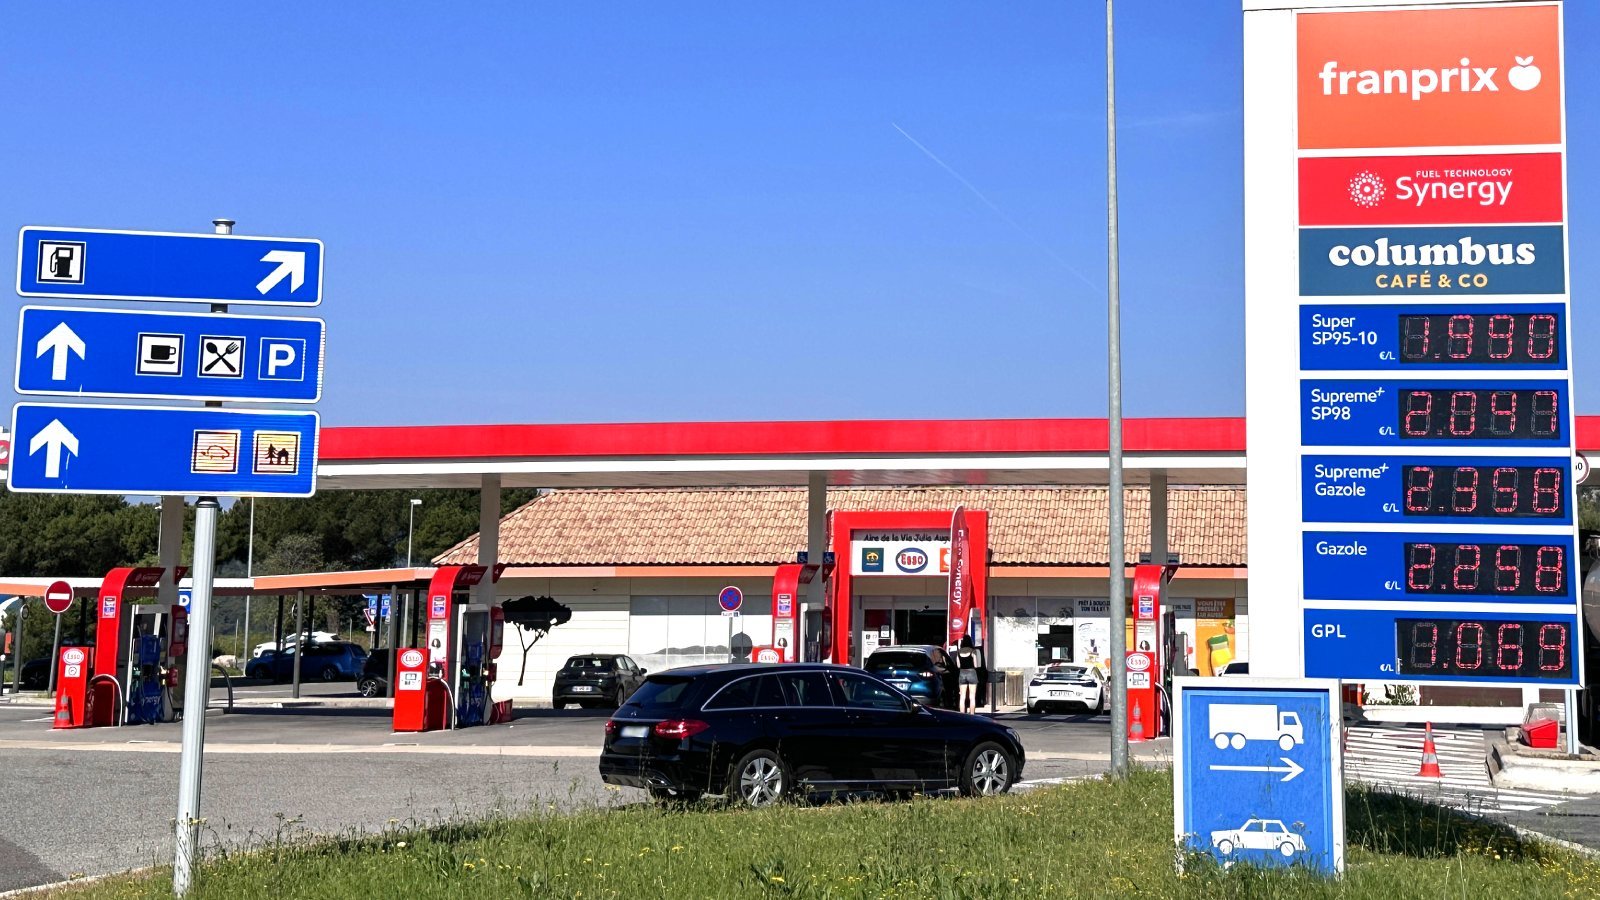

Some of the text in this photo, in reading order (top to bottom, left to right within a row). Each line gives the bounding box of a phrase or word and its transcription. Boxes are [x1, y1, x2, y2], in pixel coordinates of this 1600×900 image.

[1318, 58, 1499, 100] franprix
[1415, 168, 1513, 178] FUEL TECHNOLOGY
[1395, 176, 1513, 206] Synergy
[1328, 236, 1536, 267] columbus
[1375, 270, 1488, 288] CAFÉ & CO
[1312, 313, 1356, 329] Super
[1312, 314, 1556, 359] SP95-10 1.990
[268, 344, 296, 376] P
[1379, 350, 1396, 360] €/L
[1311, 390, 1557, 436] SP98 2.047
[1379, 426, 1396, 436] €/L
[1314, 482, 1366, 497] Gazole
[1382, 503, 1400, 513] €/L
[864, 533, 880, 542] Aire
[880, 533, 890, 542] de
[892, 533, 899, 542] la
[900, 533, 913, 542] Via
[934, 534, 951, 544] Aug
[900, 553, 924, 566] Esso
[1316, 540, 1563, 592] Gazole 2.258
[1384, 580, 1402, 590] €/L
[1311, 624, 1346, 638] GPL
[1380, 663, 1394, 673] €/L
